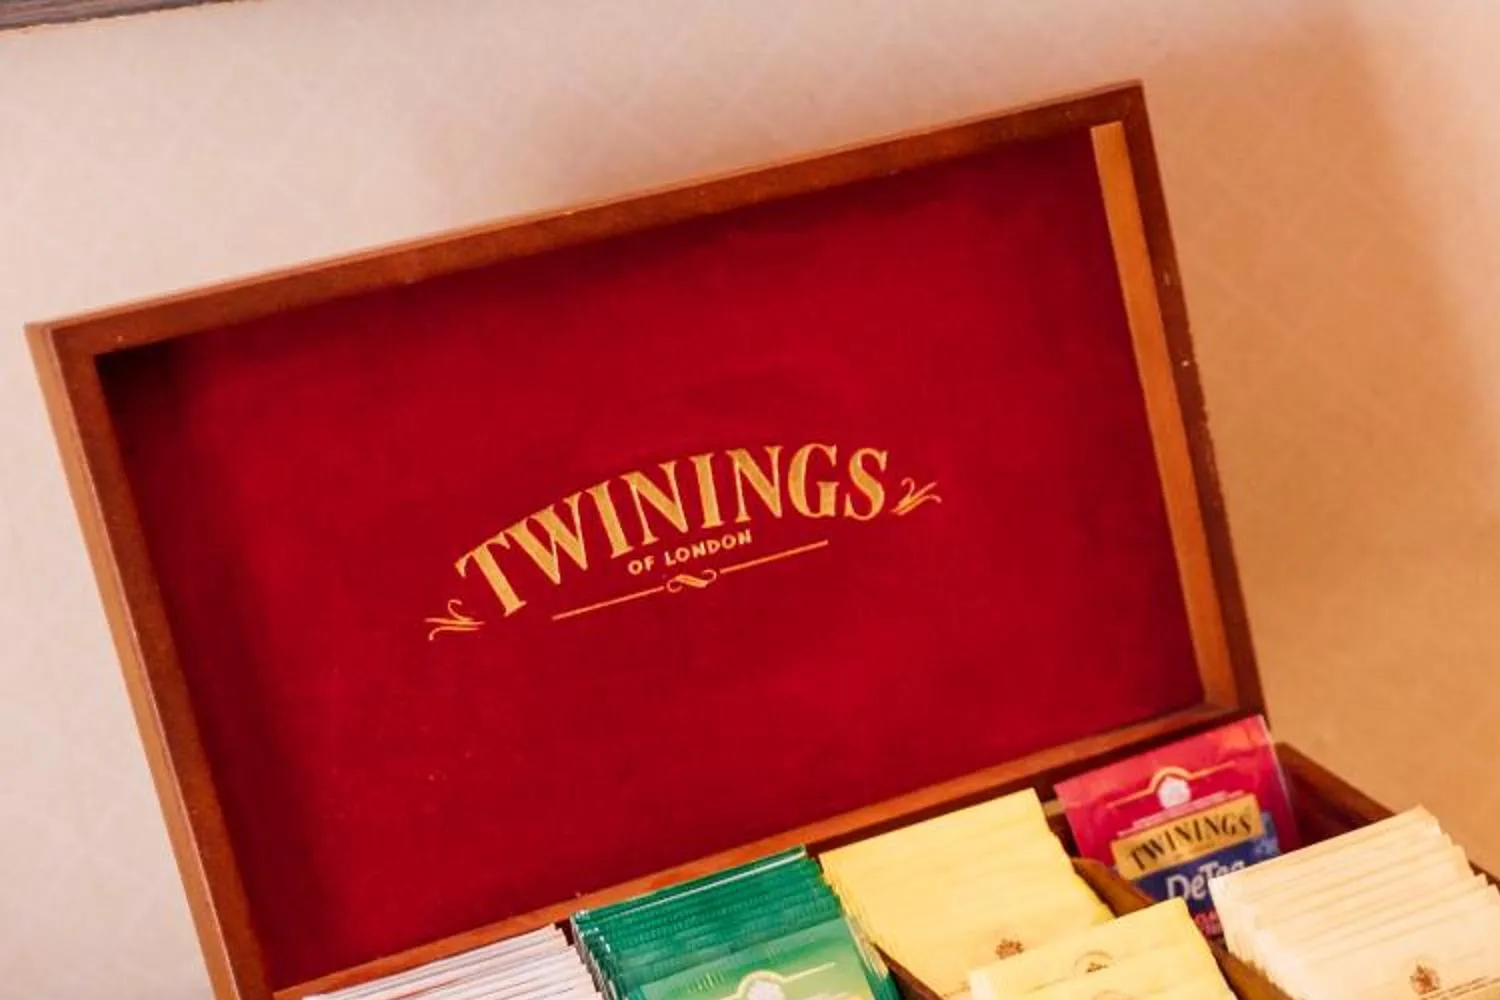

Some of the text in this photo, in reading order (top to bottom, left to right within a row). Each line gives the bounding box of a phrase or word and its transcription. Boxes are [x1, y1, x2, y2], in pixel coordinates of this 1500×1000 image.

[455, 443, 888, 617] TWININGS
[627, 529, 753, 575] OF LONDON
[1129, 813, 1252, 871] TWININGS
